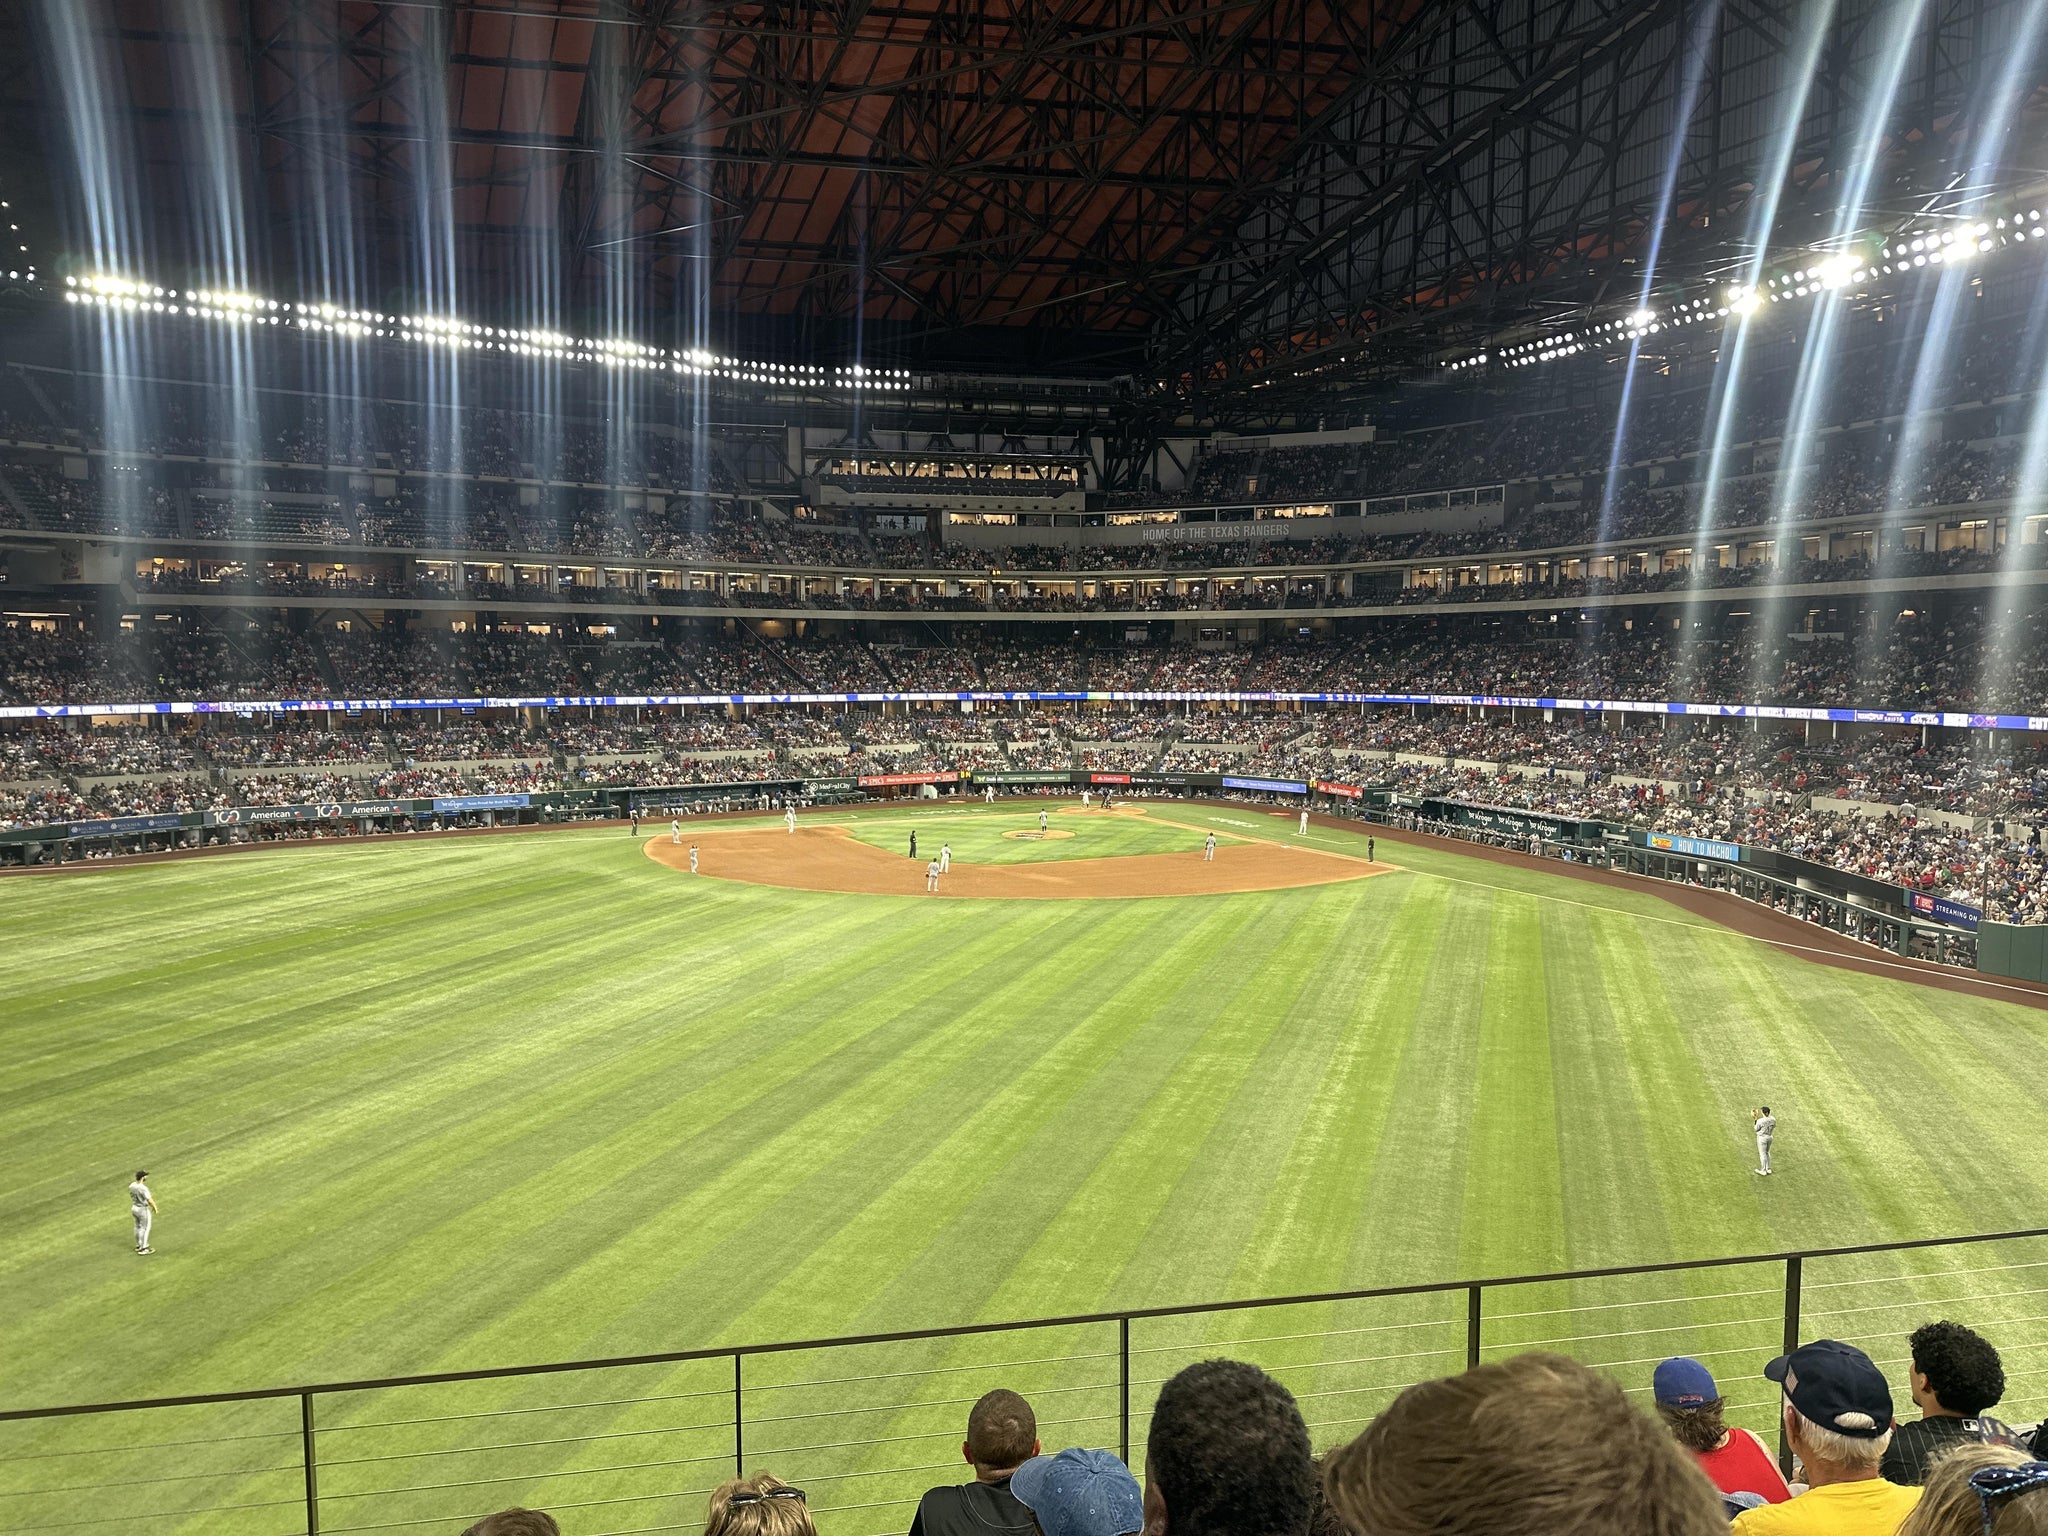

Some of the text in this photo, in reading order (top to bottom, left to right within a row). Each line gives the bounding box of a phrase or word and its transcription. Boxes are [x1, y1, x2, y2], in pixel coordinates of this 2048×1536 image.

[1143, 524, 1290, 540] HOME OF THE TEXAS RANGERS
[840, 782, 851, 790] City
[1398, 796, 1413, 804] TOYOTA
[250, 810, 291, 820] American
[314, 804, 342, 818] 100
[351, 805, 390, 814] American
[213, 810, 240, 824] 100
[1475, 811, 1493, 826] Kroger
[1504, 816, 1525, 831] Kroger
[1537, 820, 1558, 837] Kroger
[1678, 839, 1693, 854] HOW
[1696, 842, 1705, 855] TO
[1707, 843, 1732, 861] NACHO!
[1936, 905, 1967, 919] STREAMING
[1968, 914, 1978, 922] ON
